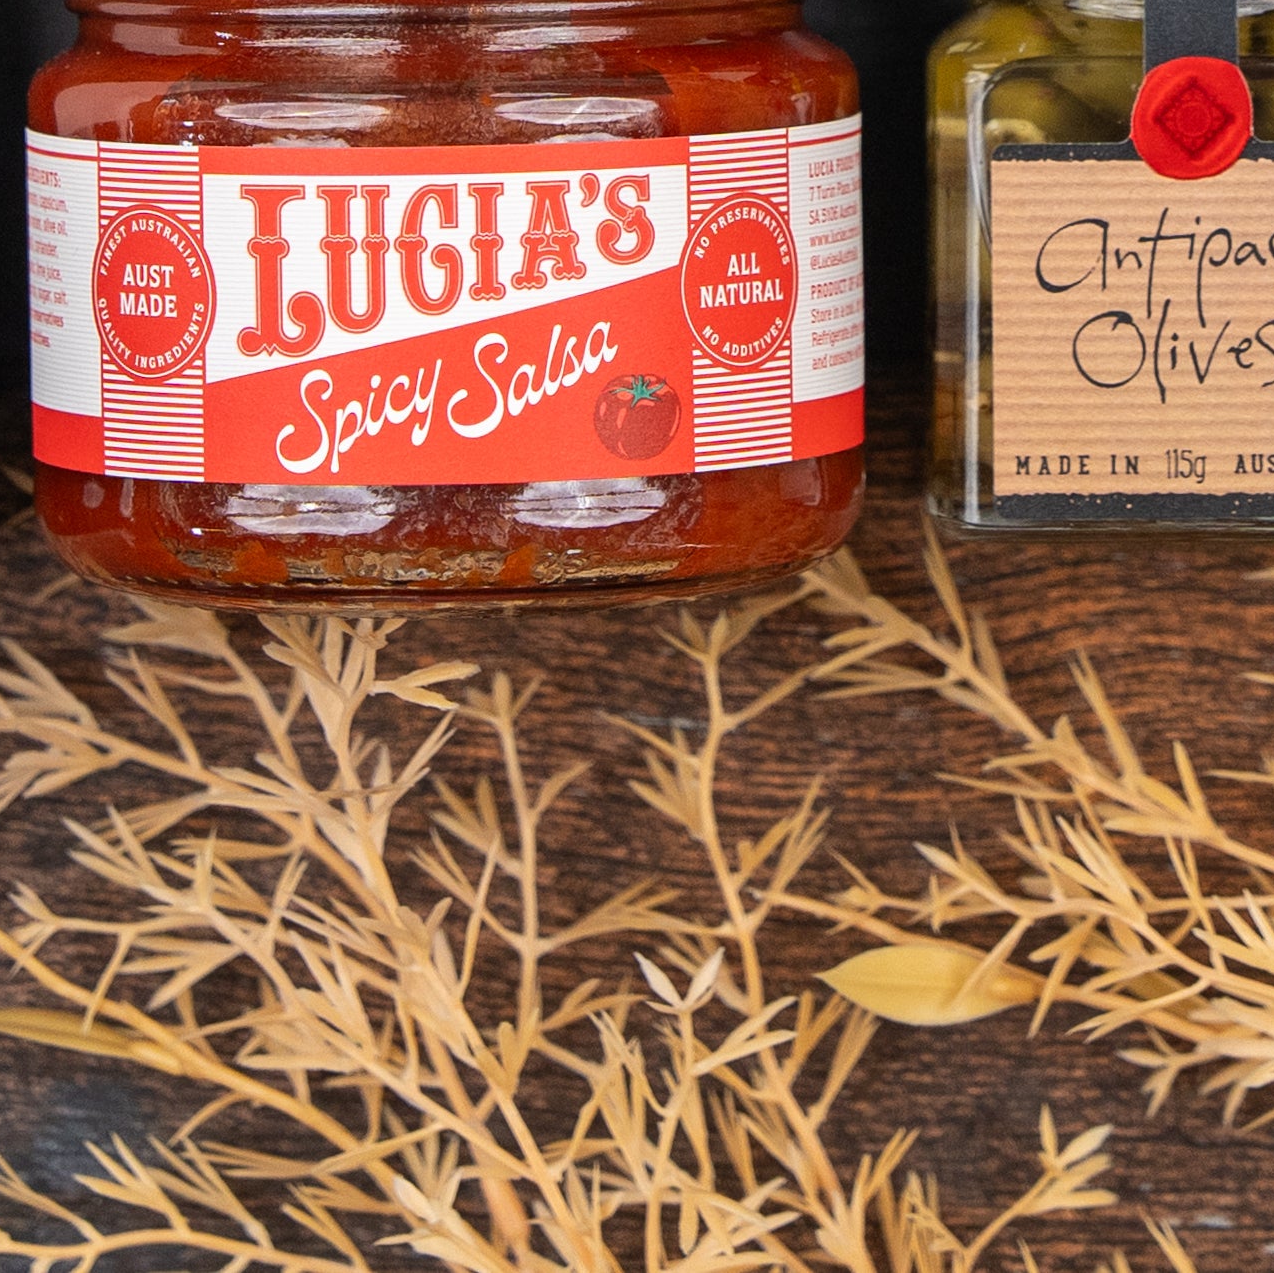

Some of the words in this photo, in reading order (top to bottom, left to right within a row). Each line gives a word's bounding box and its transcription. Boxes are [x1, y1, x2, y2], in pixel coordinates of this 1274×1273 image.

[808, 160, 834, 178] LUCIA
[100, 225, 128, 276] FINEST
[131, 219, 201, 278] AUSTRALIAN
[694, 236, 710, 259] NO
[711, 207, 791, 265] PRESERVATIVES
[123, 263, 174, 288] AUST
[237, 173, 655, 358] LUCIA'S
[727, 252, 760, 277] ALL
[120, 292, 178, 318] MADE
[700, 278, 784, 309] NATURAL
[98, 298, 132, 360] QUALITY
[134, 303, 205, 369] INGREDIENTS
[702, 325, 720, 346] NO
[722, 316, 783, 357] ADDITIVES
[276, 358, 443, 474] Spicy
[447, 320, 619, 439] Salsa
[1016, 454, 1091, 476] MADE
[1110, 453, 1140, 475] IN
[1164, 449, 1207, 484] 115g
